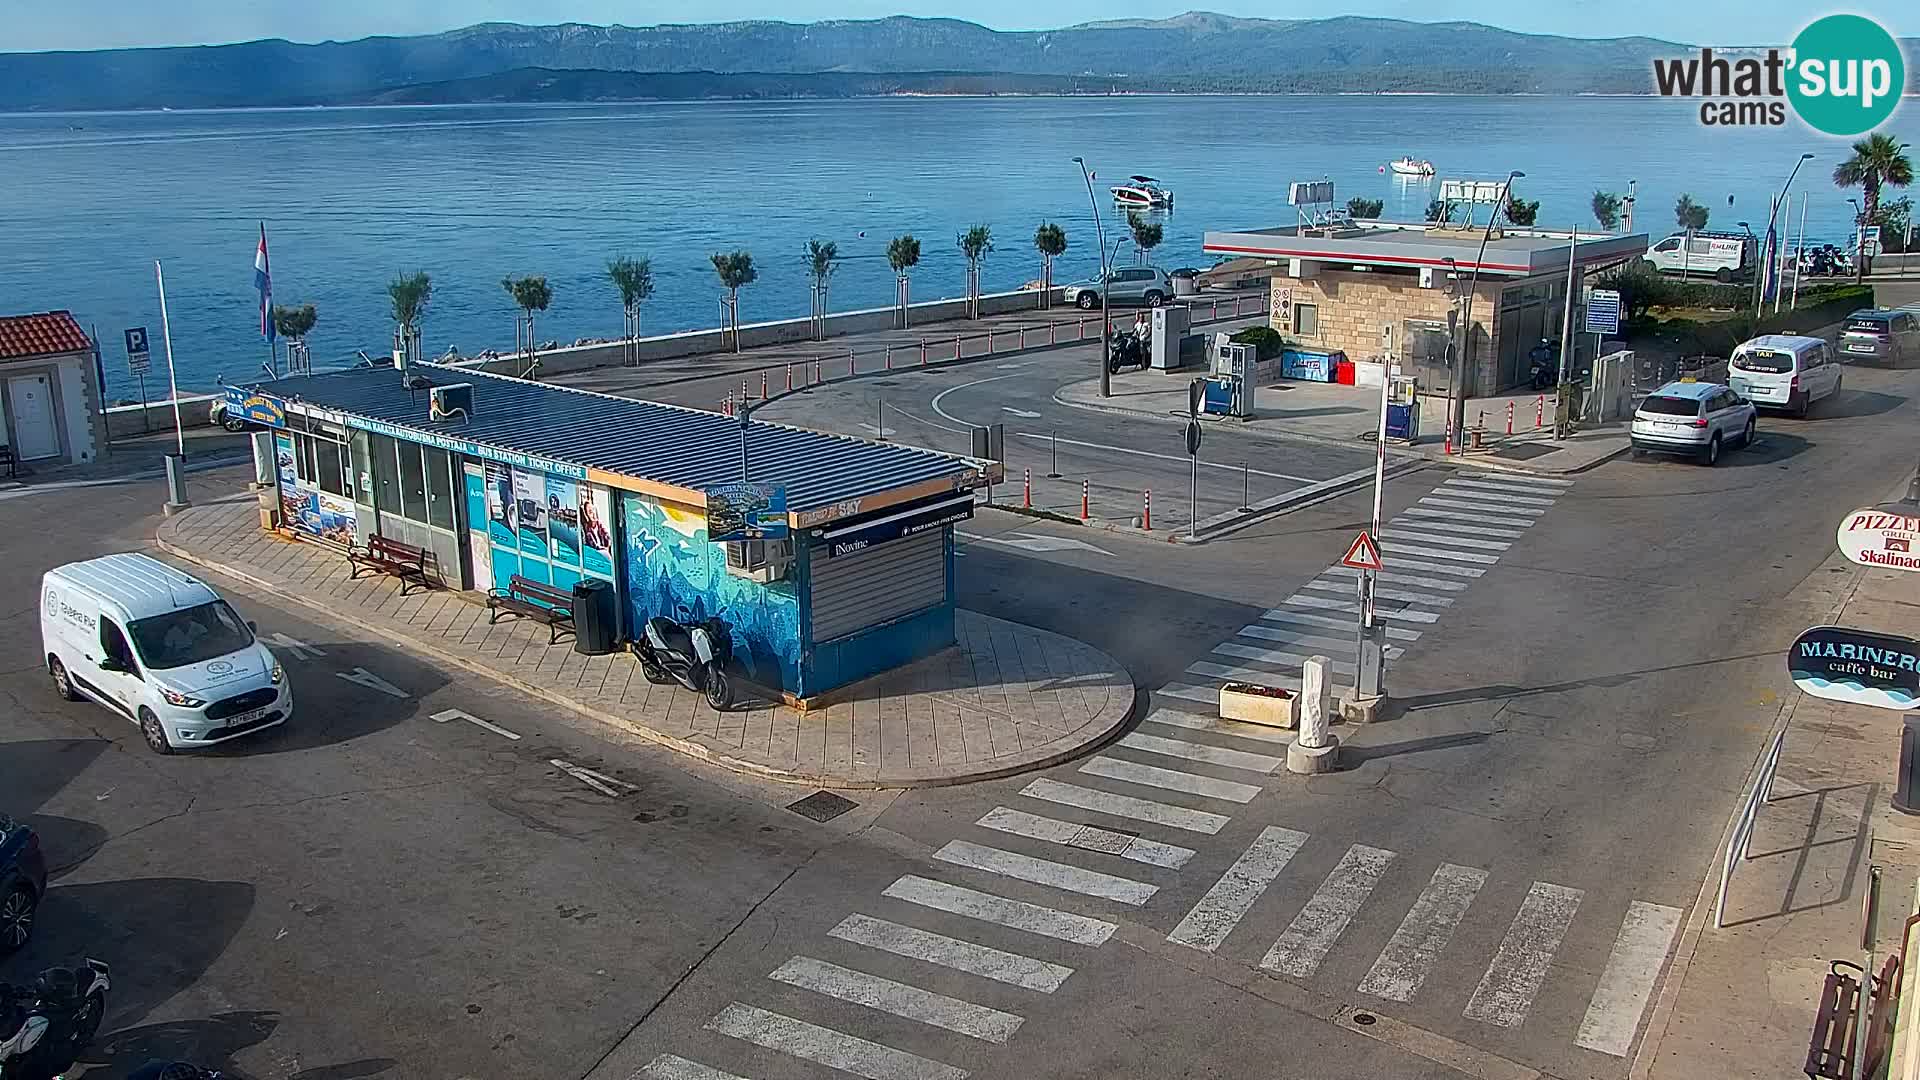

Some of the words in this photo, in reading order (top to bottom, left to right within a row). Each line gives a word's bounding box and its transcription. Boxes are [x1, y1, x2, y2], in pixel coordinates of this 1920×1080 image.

[130, 331, 142, 350] P
[395, 426, 435, 445] AUTOBUSNA
[436, 436, 467, 451] POSTAJA
[478, 445, 492, 456] BUS
[494, 448, 526, 466] STATION
[528, 457, 554, 472] TICKET
[555, 463, 582, 477] OFFICE
[951, 512, 968, 521] CHOICE
[1848, 515, 1920, 533] PIZZE
[1881, 530, 1917, 540] GRILL
[1829, 660, 1866, 676] caffe
[1870, 665, 1897, 680] bar
